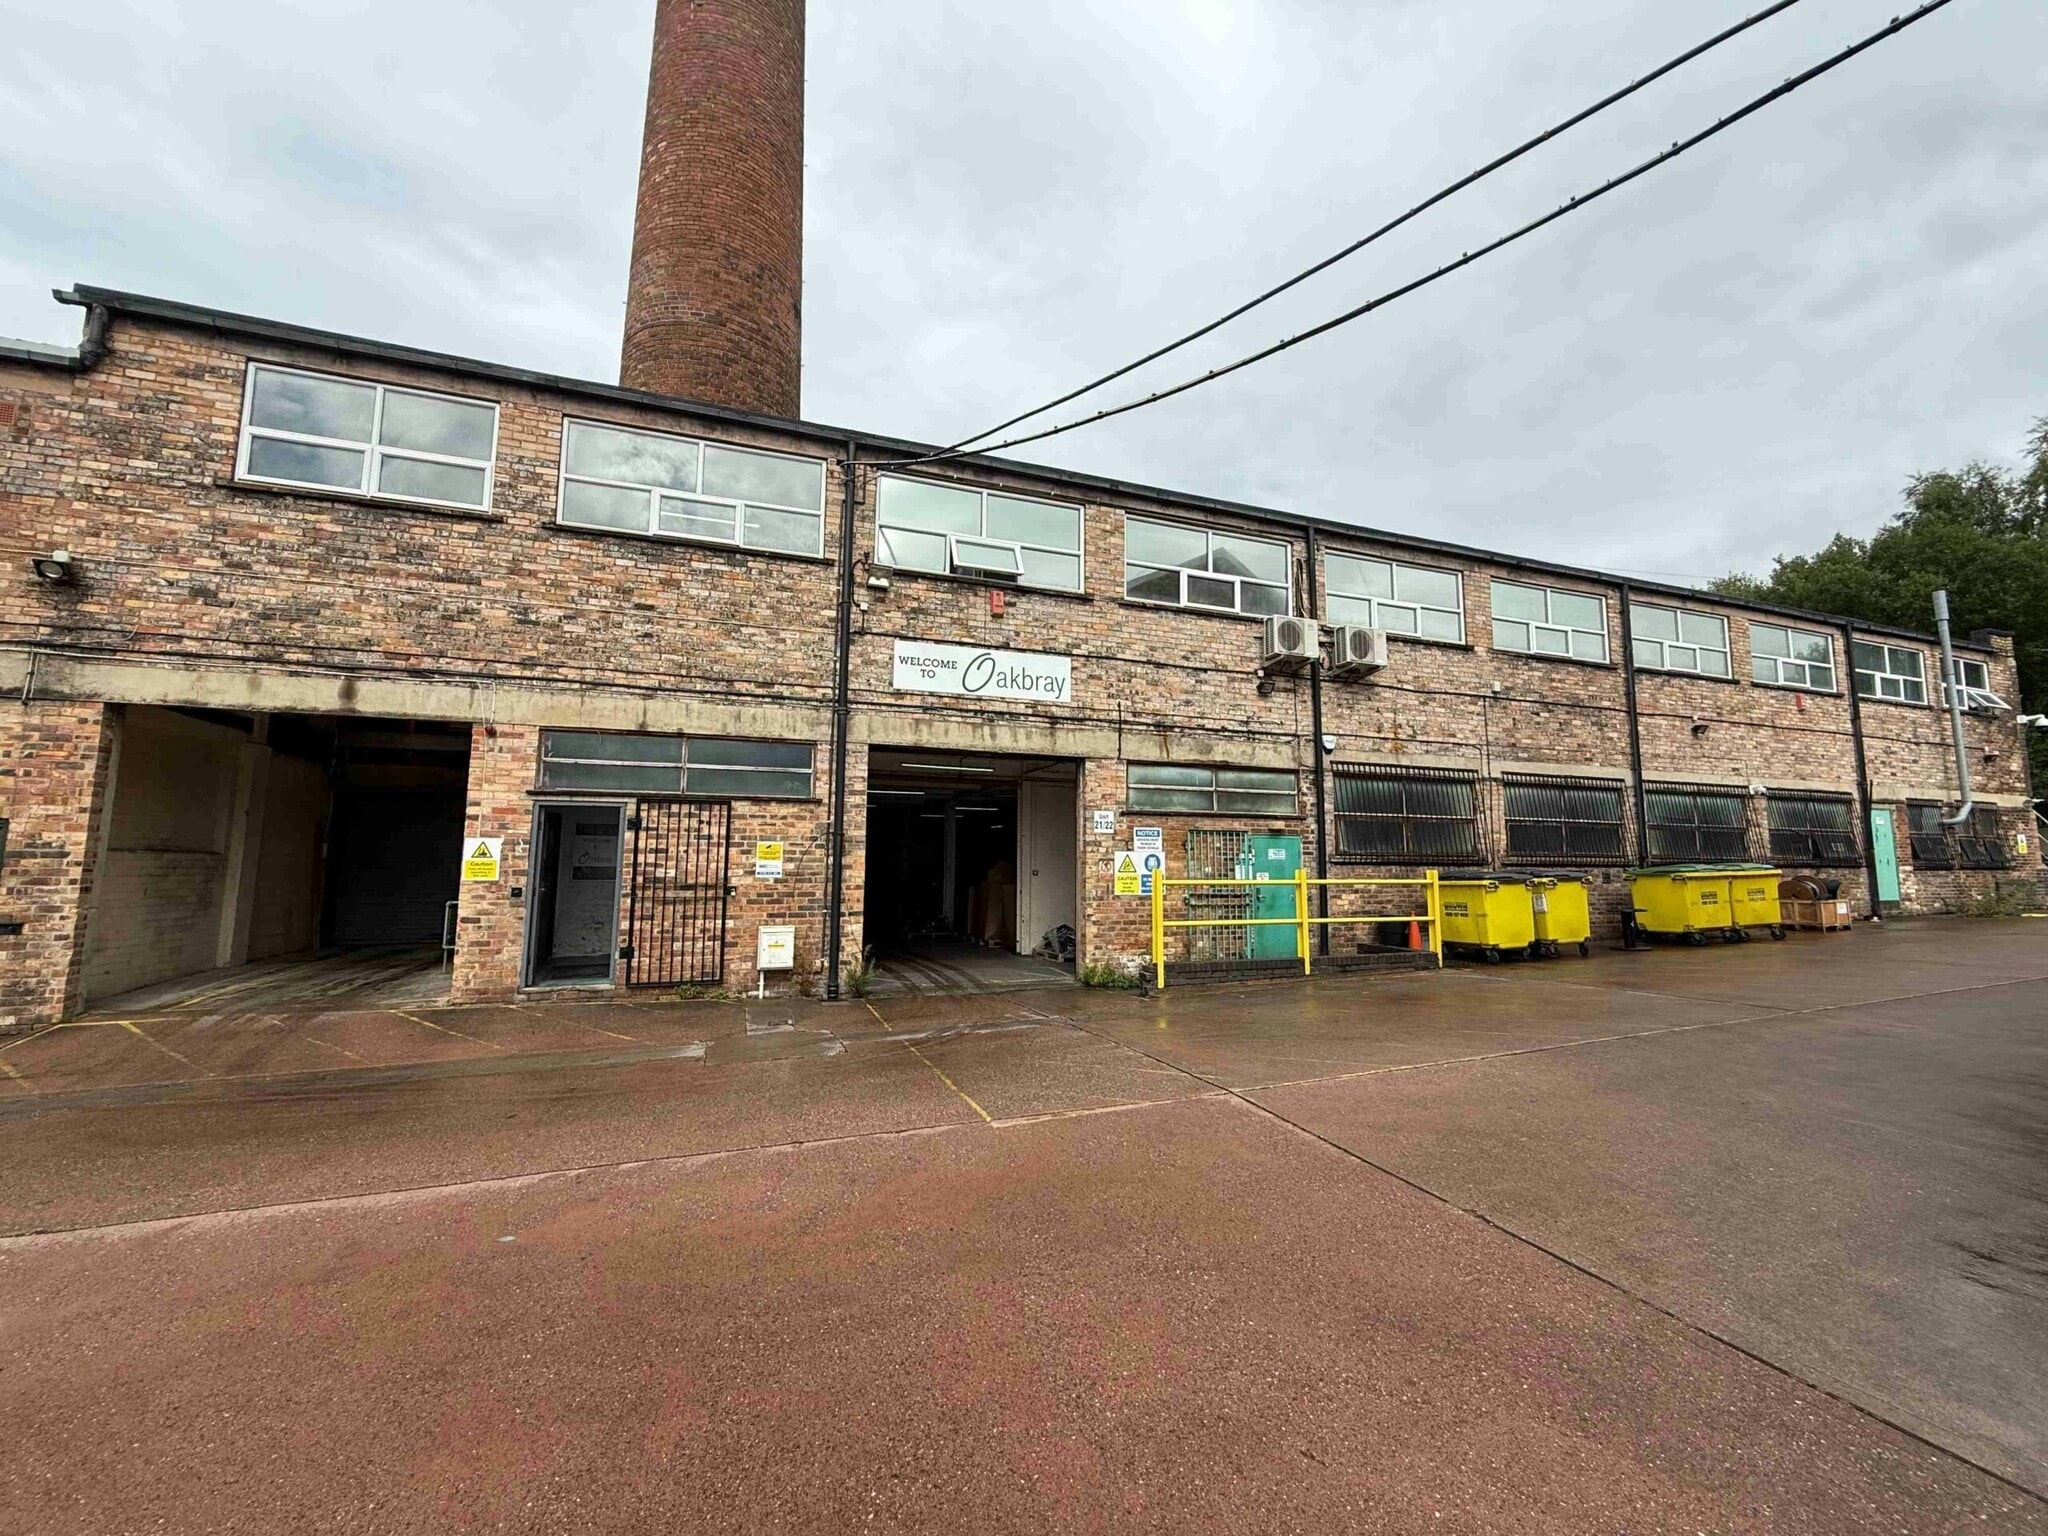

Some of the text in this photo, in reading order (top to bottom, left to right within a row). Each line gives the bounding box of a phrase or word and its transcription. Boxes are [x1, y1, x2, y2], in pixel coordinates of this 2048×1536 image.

[898, 656, 958, 669] WELCOME
[920, 669, 936, 678] TO
[962, 653, 1065, 699] Oakbray
[1095, 821, 1113, 829] 21/22
